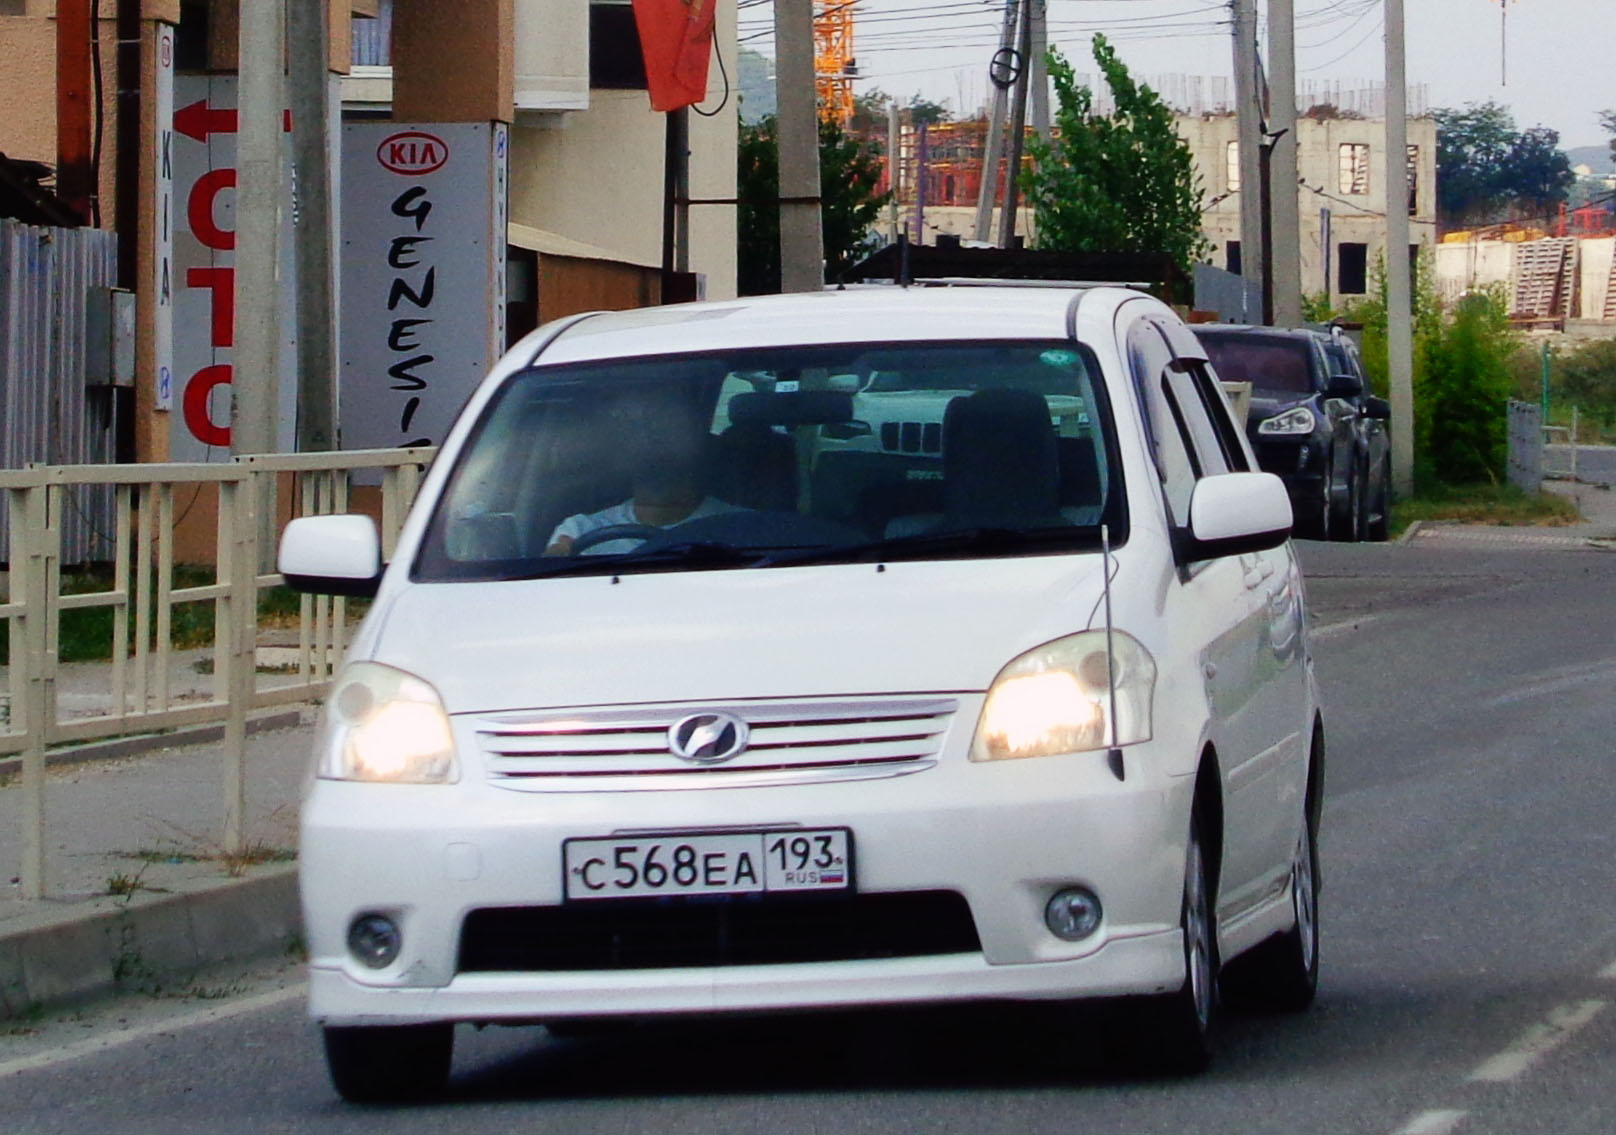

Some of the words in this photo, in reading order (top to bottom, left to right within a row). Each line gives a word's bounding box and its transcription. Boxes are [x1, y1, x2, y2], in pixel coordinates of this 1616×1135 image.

[390, 143, 437, 164] KIA
[387, 186, 436, 448] GENESI
[770, 835, 834, 870] 193
[786, 872, 817, 884] RUS
